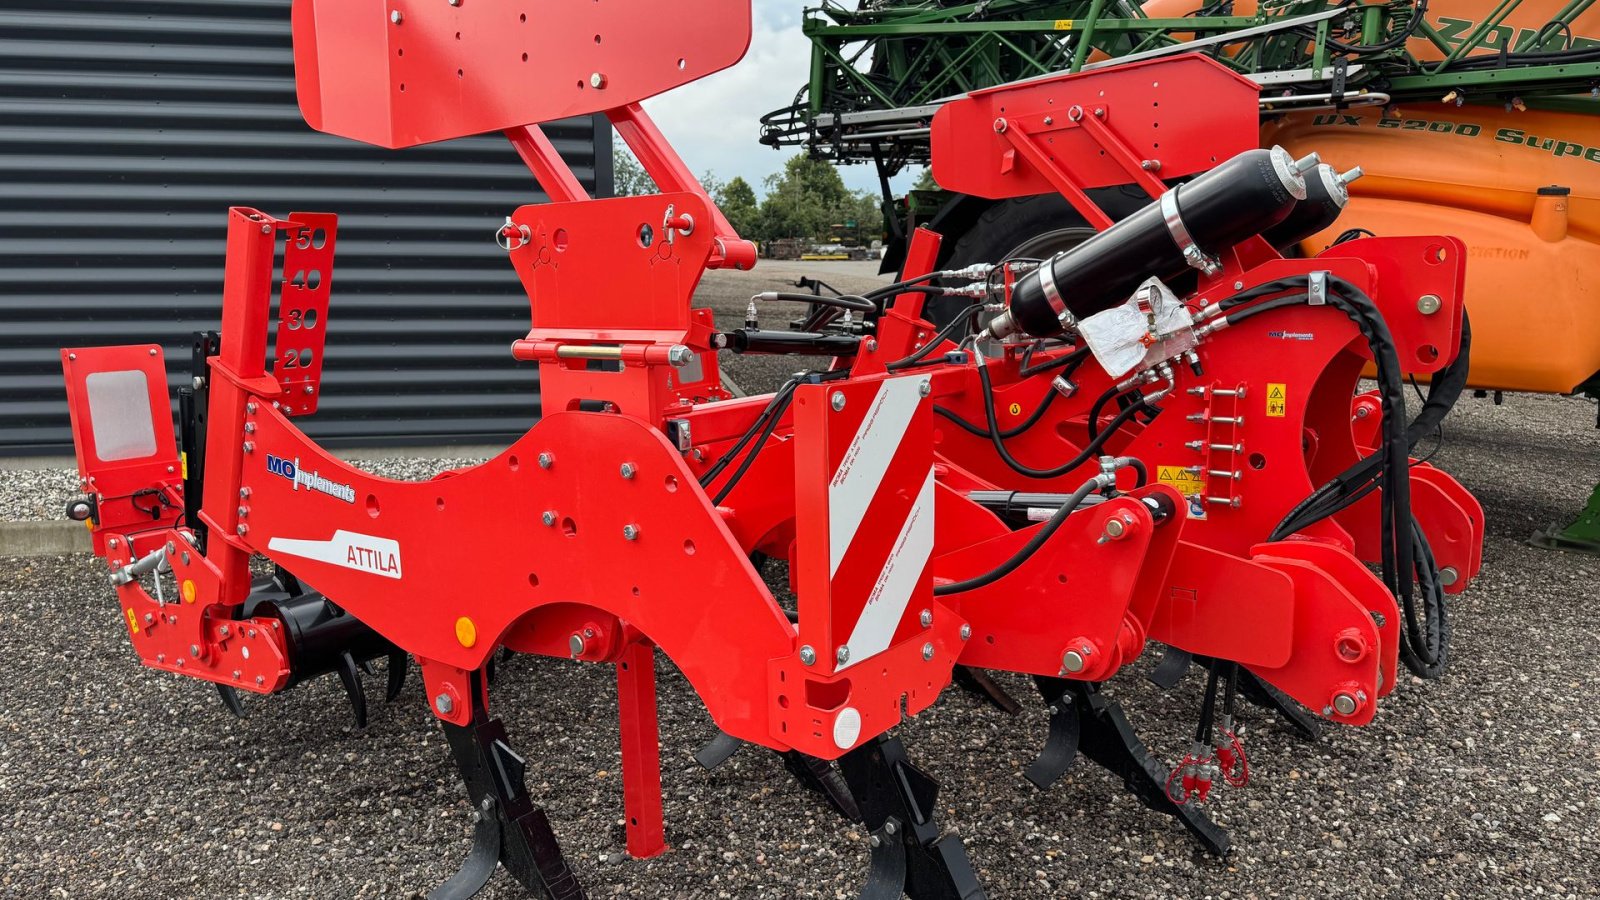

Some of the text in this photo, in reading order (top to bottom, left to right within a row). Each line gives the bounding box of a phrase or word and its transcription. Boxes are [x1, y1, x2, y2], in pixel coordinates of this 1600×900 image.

[1311, 113, 1368, 127] UX
[1376, 117, 1482, 138] 5200
[295, 227, 327, 250] 50
[290, 269, 322, 291] 40
[287, 308, 318, 331] 30
[282, 347, 314, 370] 20
[347, 545, 399, 574] ATTILA
